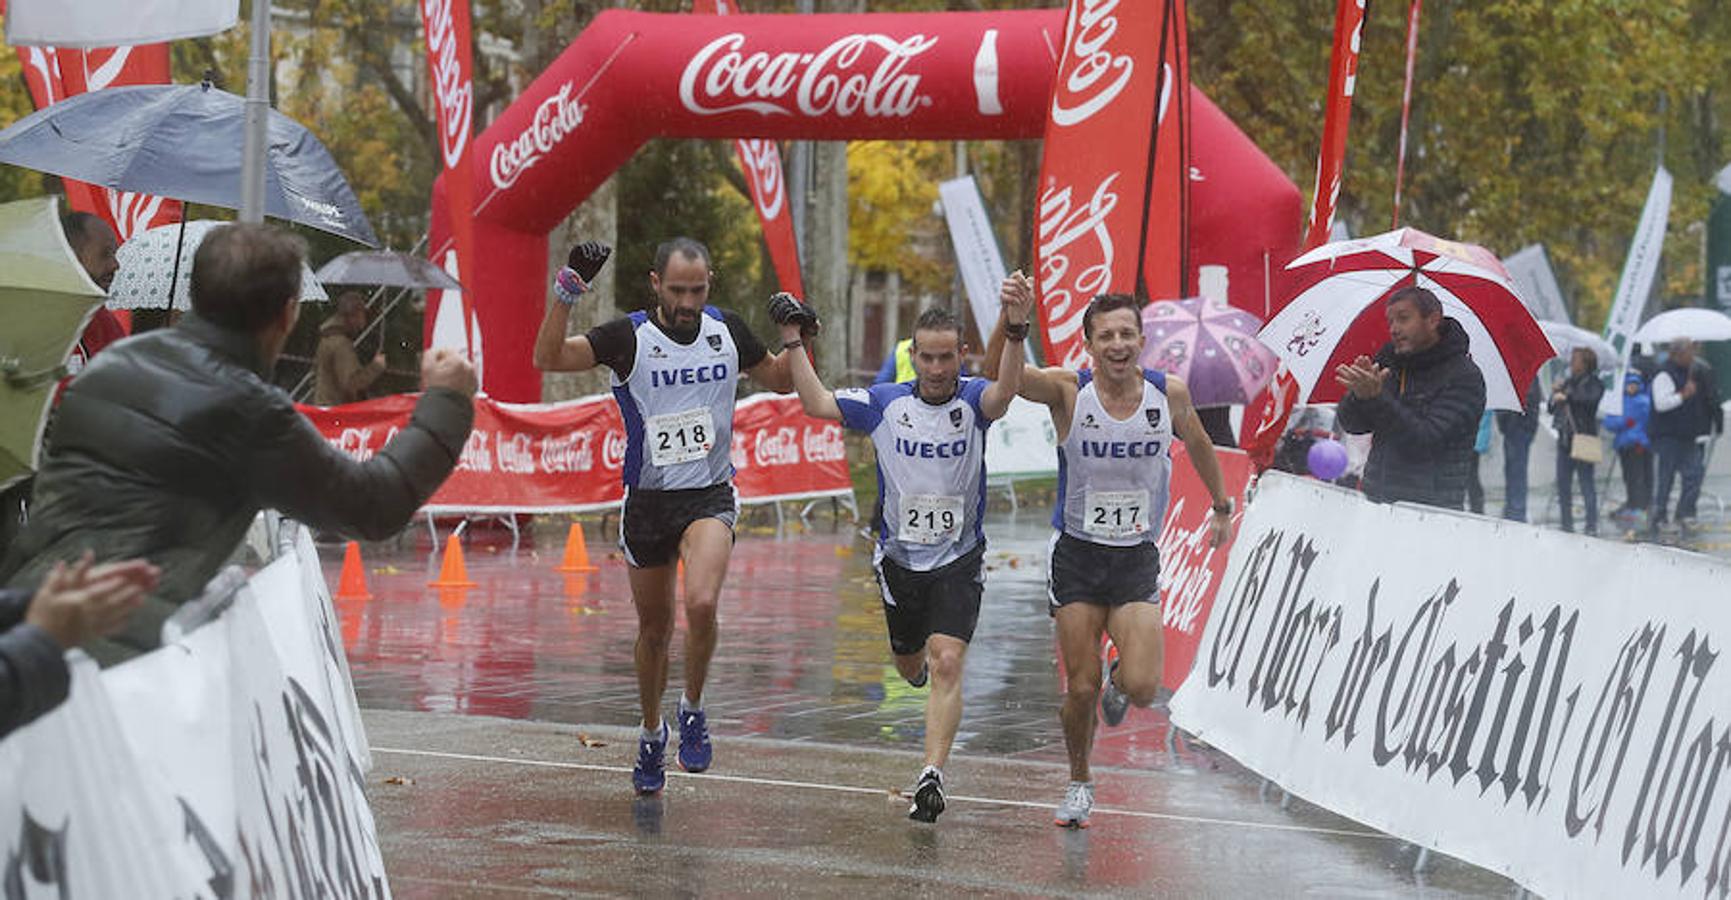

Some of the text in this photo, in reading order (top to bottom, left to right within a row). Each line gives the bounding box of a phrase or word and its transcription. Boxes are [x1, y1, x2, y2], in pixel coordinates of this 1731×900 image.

[680, 33, 938, 118] Coca-Cola
[490, 80, 584, 190] Coca-Cola
[651, 363, 728, 388] IVECO
[657, 424, 706, 451] 218
[895, 437, 968, 459] IVECO
[1081, 439, 1161, 459] IVECO
[908, 508, 955, 530] 219
[1093, 506, 1140, 526] 217
[1207, 527, 1285, 690] El
[1324, 576, 1394, 752] de
[1372, 576, 1583, 814] Castill
[1564, 619, 1667, 847] El
